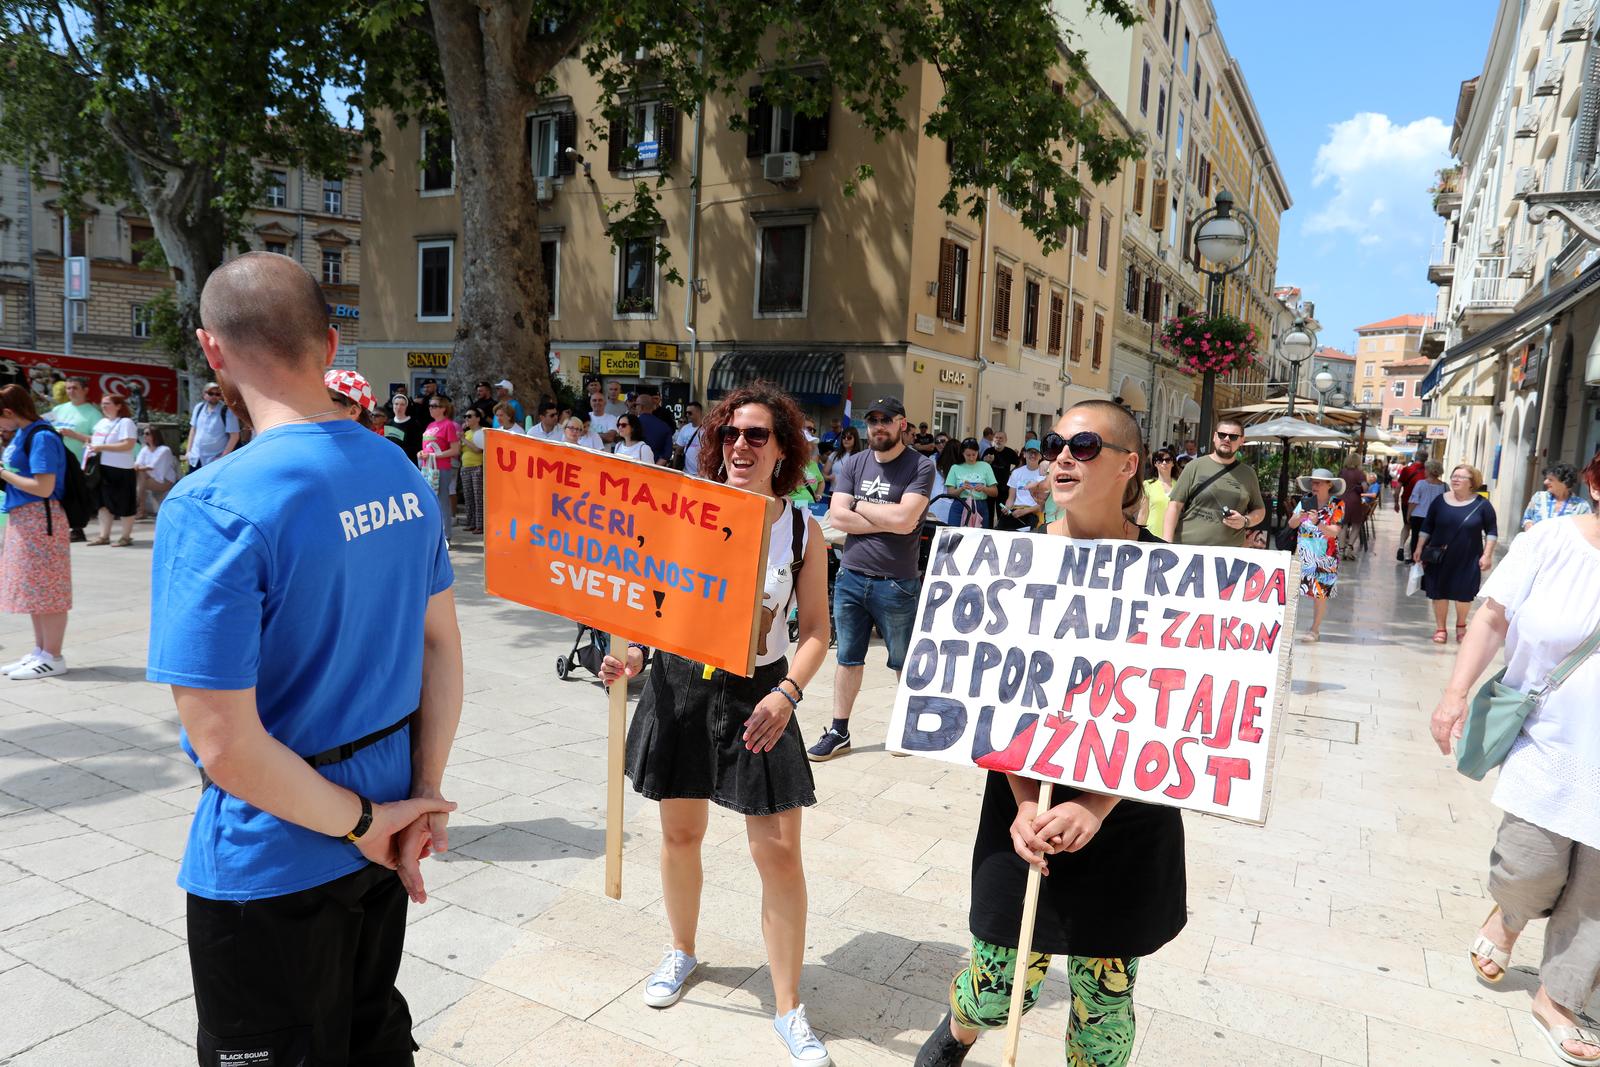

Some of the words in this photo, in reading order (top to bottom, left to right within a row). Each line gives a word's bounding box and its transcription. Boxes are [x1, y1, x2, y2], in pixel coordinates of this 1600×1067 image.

[606, 358, 640, 369] Exchan
[339, 492, 425, 542] REDAR
[496, 447, 517, 473] U
[527, 455, 582, 489] IME
[599, 471, 732, 541] MAJKE,
[551, 491, 645, 547] KĆERI,
[510, 518, 517, 541] I
[529, 523, 728, 603] SOLIDARNOSTI
[931, 531, 1033, 576] KAD
[1057, 543, 1286, 606] NEPRAVDA
[920, 579, 1149, 645] POSTAJE
[1160, 607, 1281, 654] ZAKON
[905, 637, 1054, 710] OTPOR
[1061, 655, 1266, 750] POSTAJE
[901, 695, 1252, 807] DUŽNOST
[220, 1053, 243, 1061] BLACK
[244, 1051, 269, 1059] SQUAD
